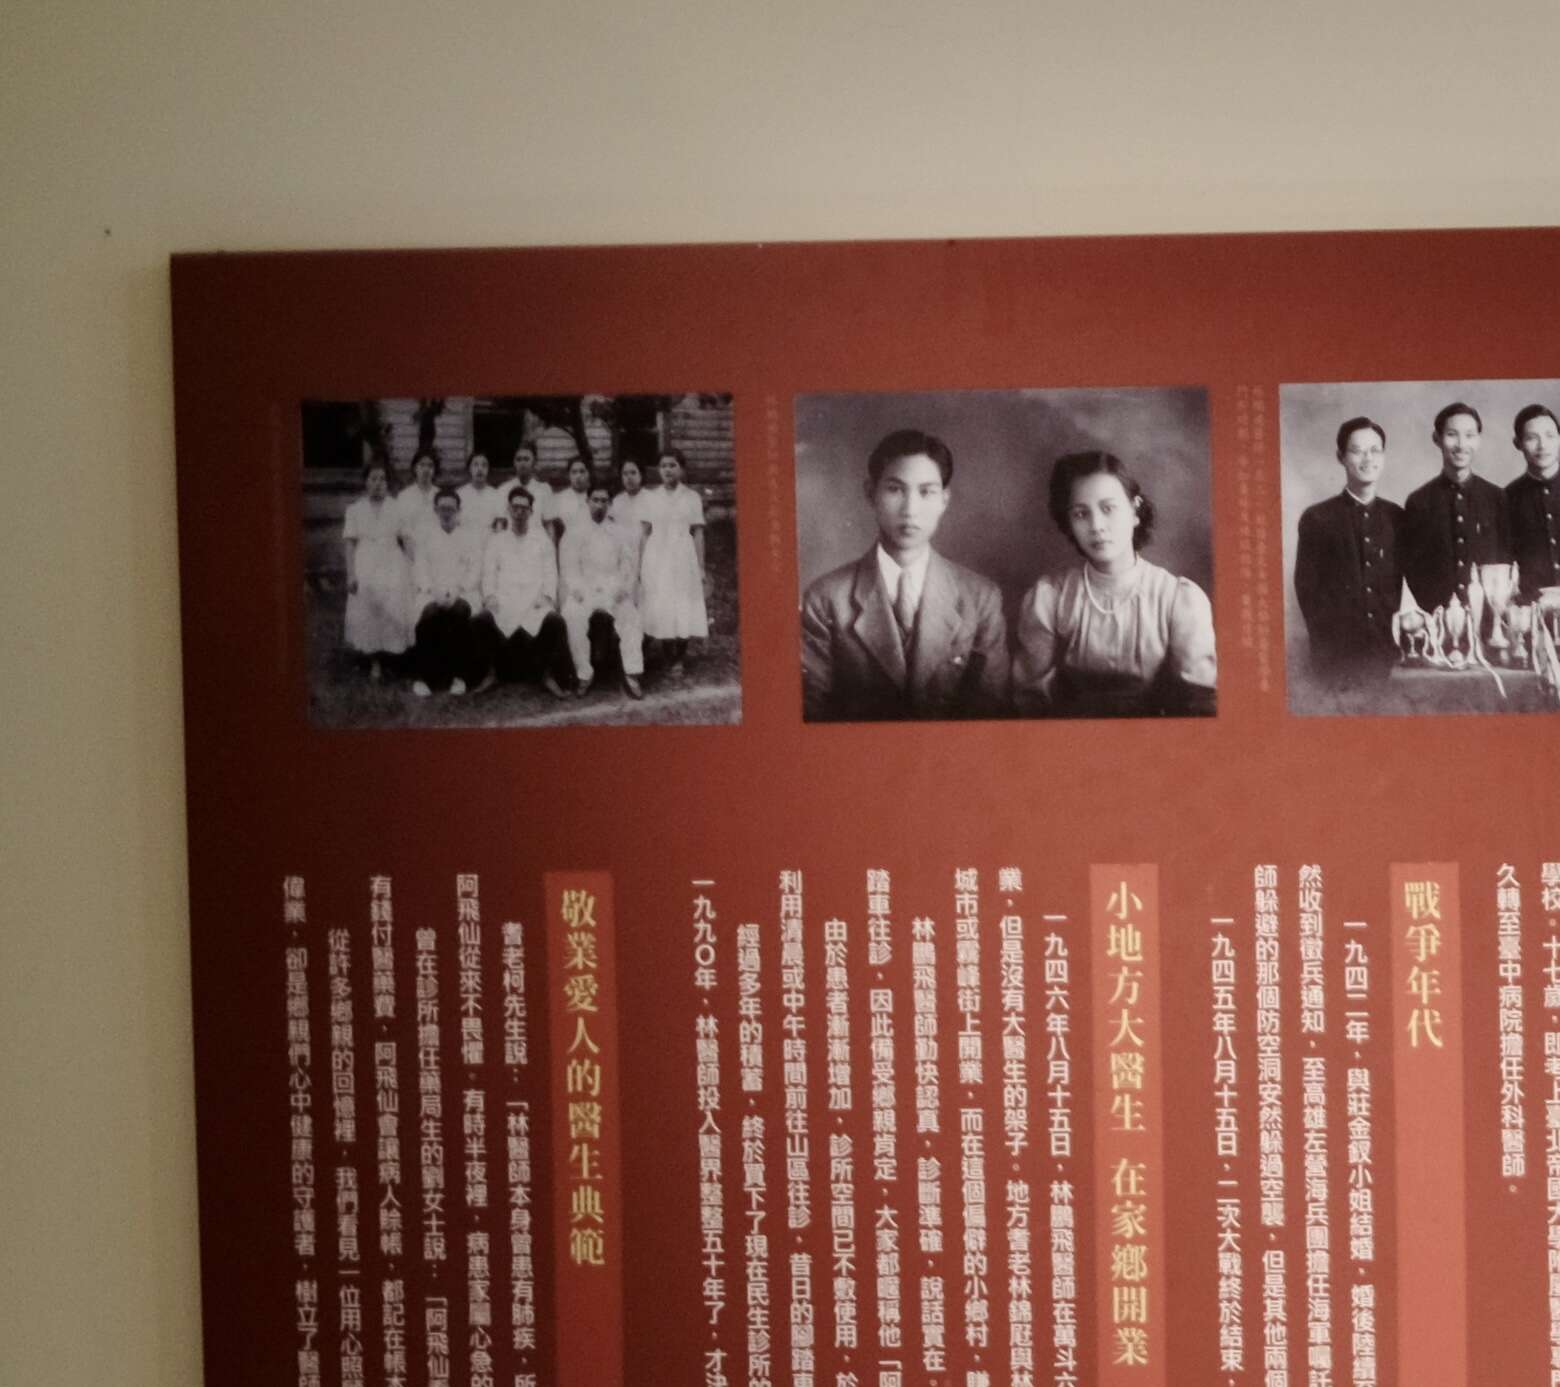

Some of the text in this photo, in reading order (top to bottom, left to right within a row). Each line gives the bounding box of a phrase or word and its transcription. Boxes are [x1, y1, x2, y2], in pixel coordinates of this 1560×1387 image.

[561, 889, 606, 1266] 敬業愛人的醫生典範
[1106, 880, 1149, 1367] 小地方大醫生 在家鄉開業
[1405, 880, 1443, 1049] 戰爭年代
